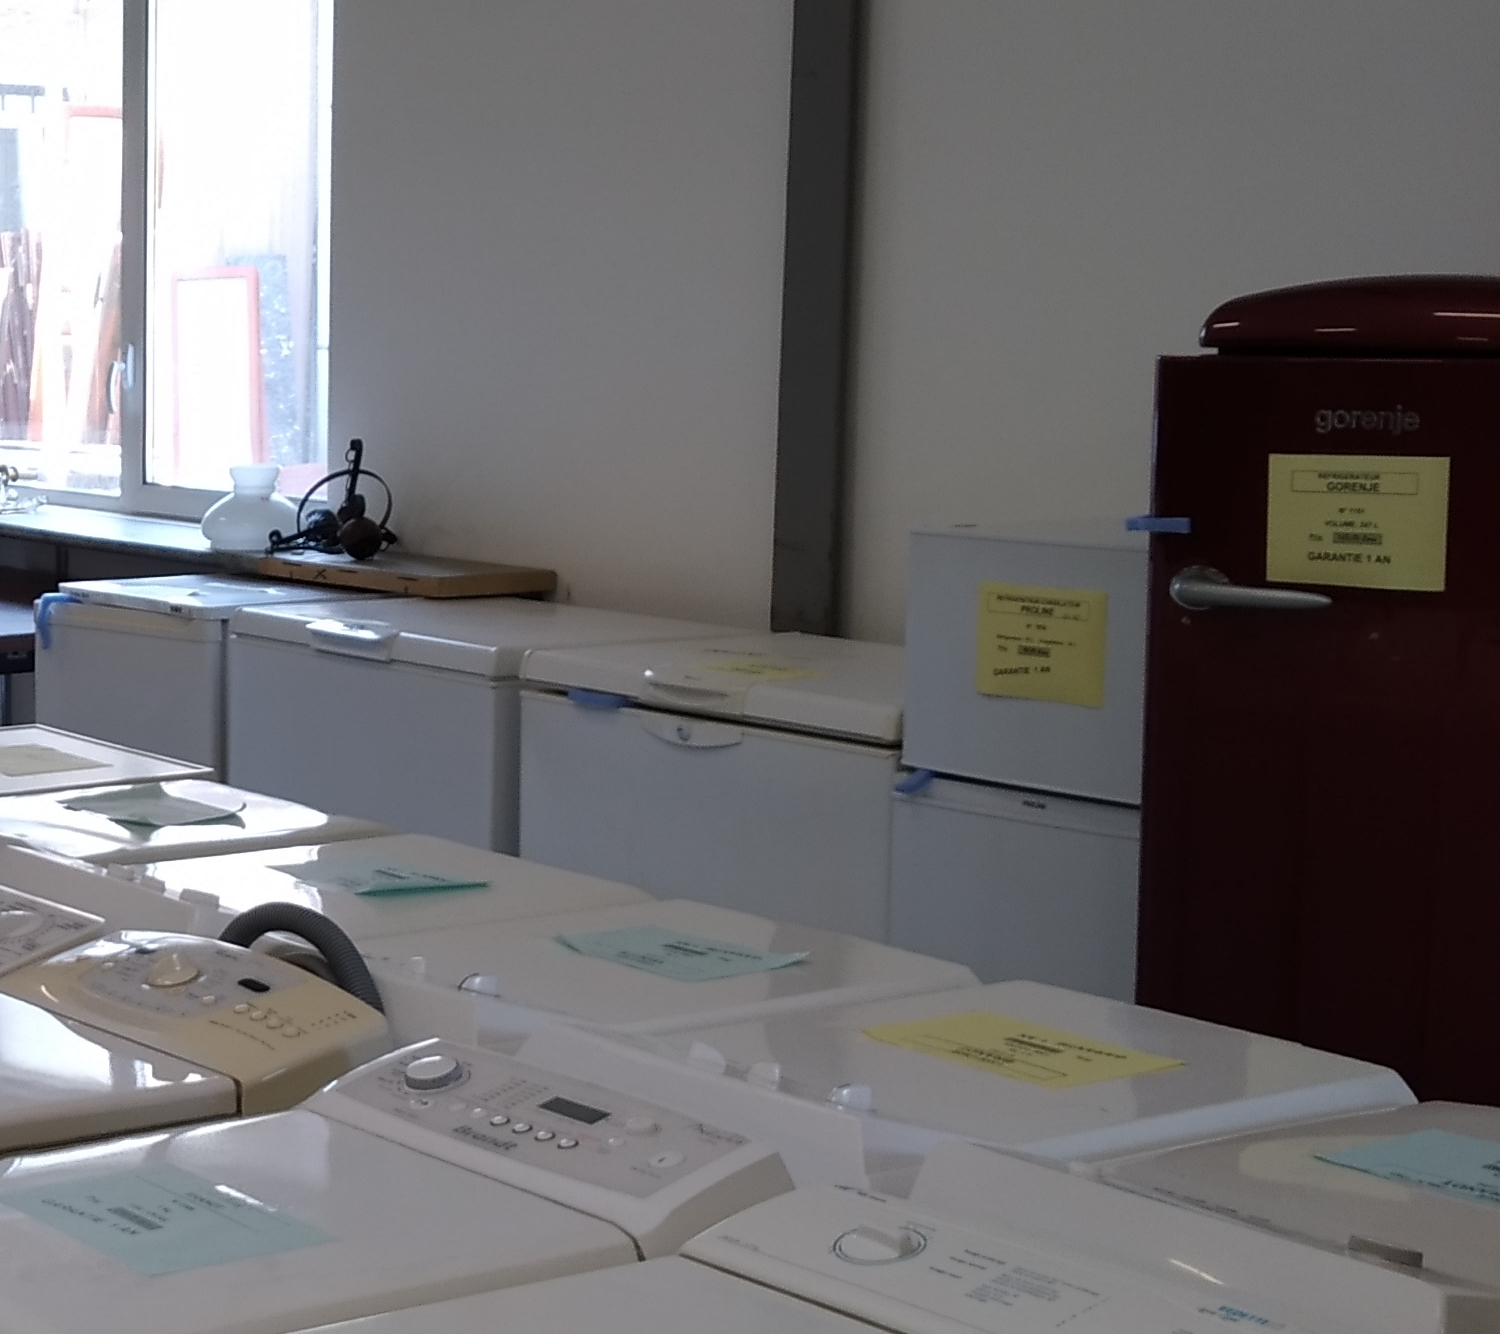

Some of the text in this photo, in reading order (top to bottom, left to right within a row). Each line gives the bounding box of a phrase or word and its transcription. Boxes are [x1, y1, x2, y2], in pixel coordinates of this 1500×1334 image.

[1314, 404, 1421, 436] gorenje
[1326, 481, 1381, 493] GORENJE
[1307, 551, 1363, 564] GARANTIE
[1374, 554, 1391, 565] AN
